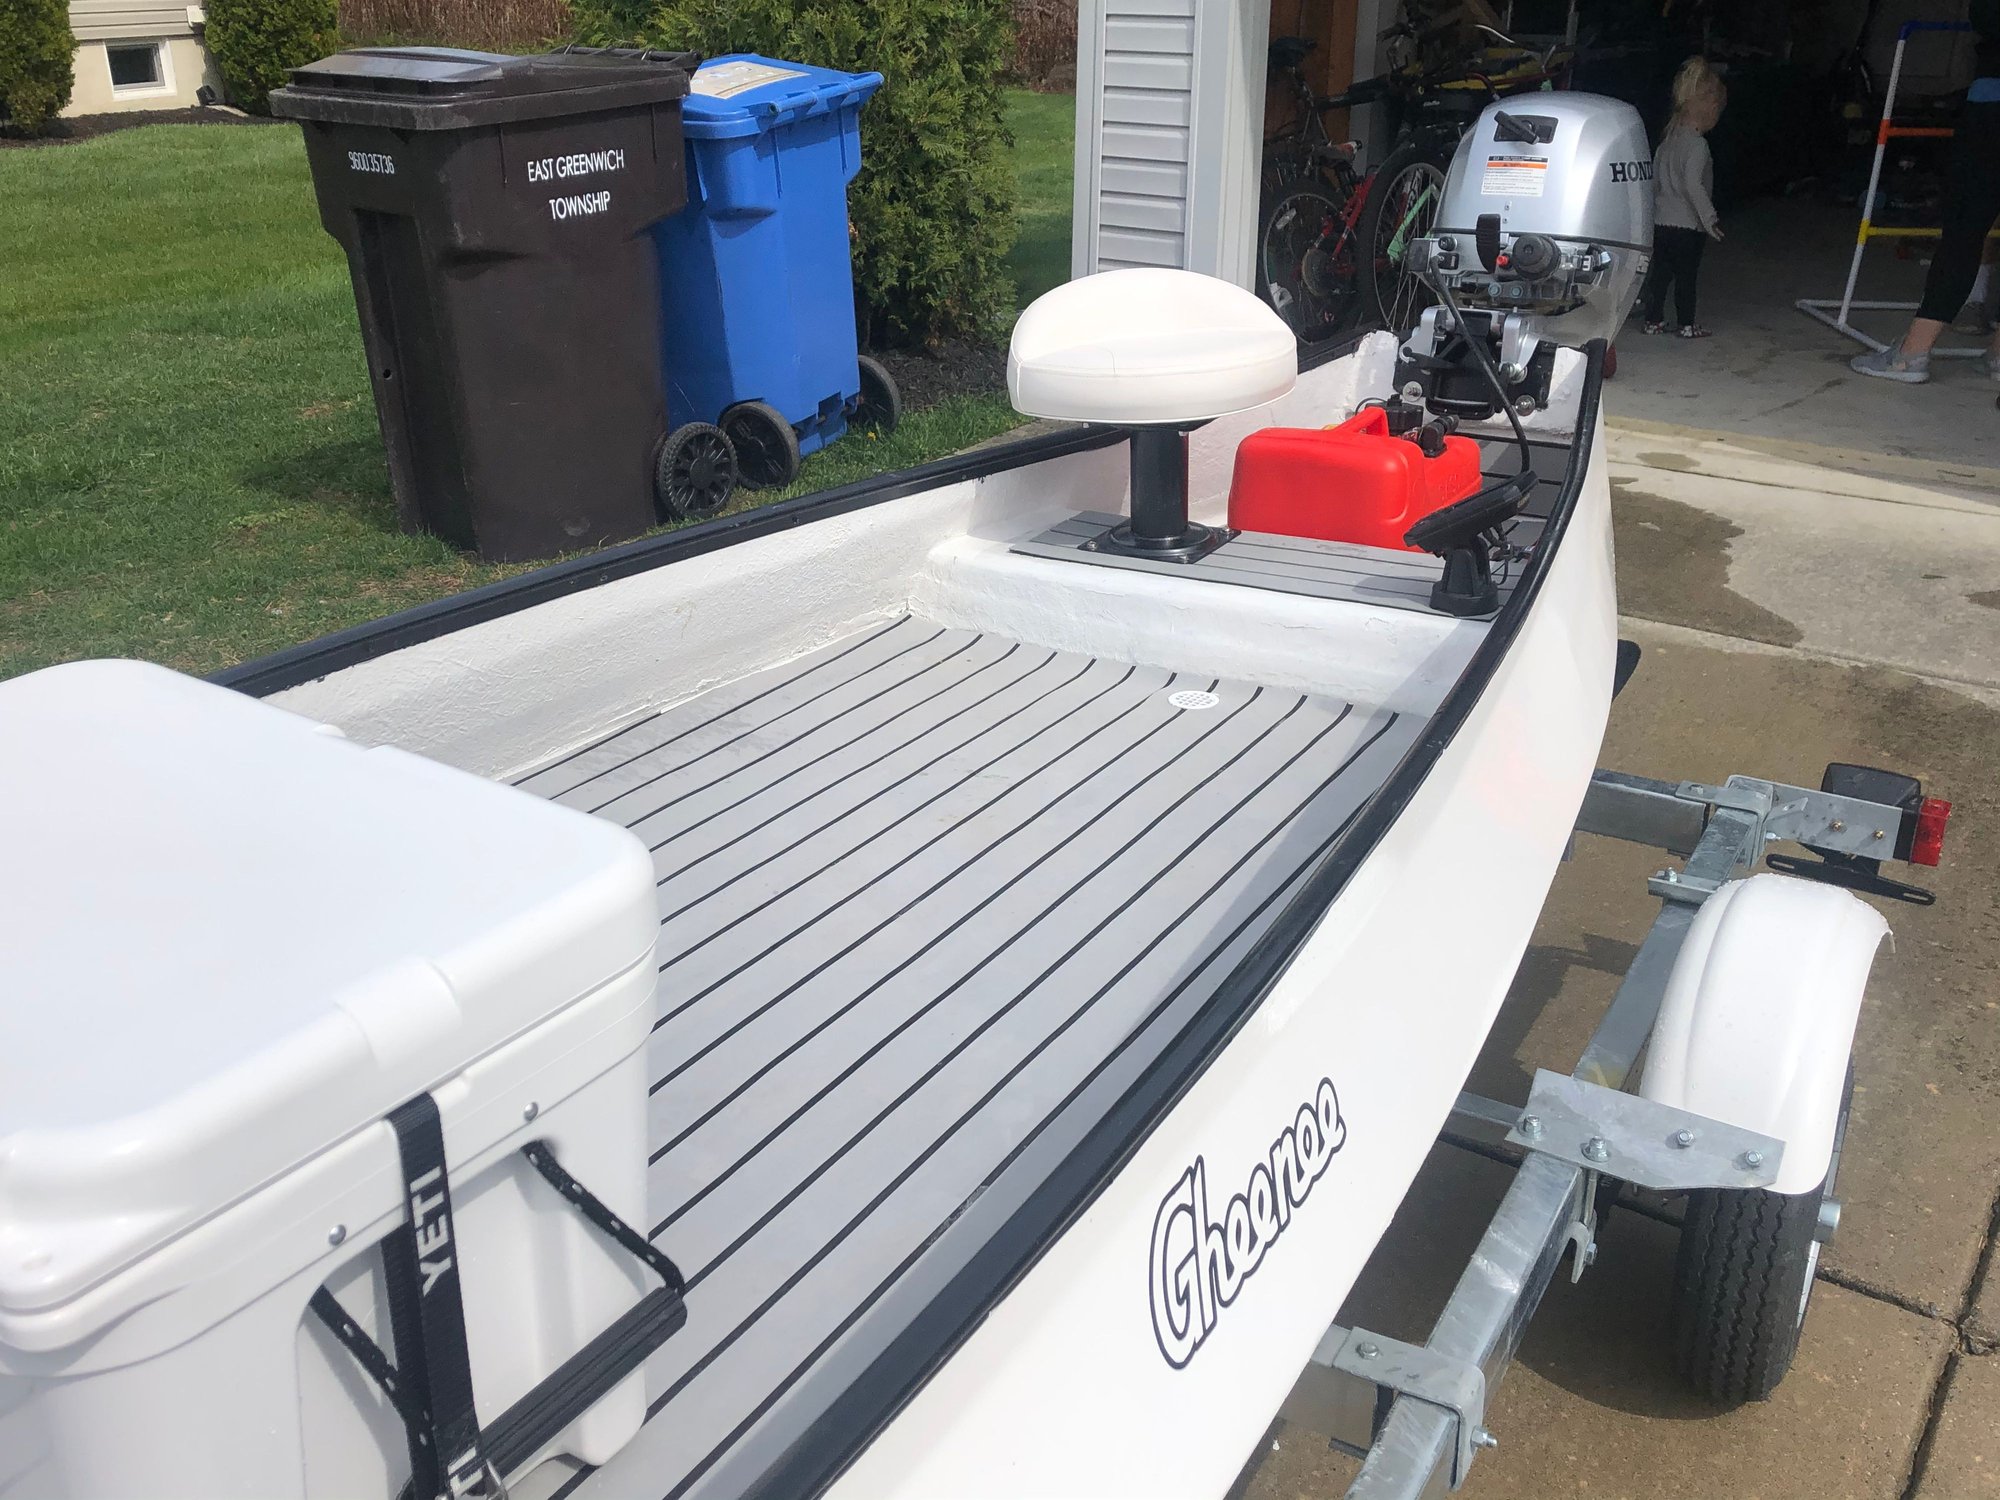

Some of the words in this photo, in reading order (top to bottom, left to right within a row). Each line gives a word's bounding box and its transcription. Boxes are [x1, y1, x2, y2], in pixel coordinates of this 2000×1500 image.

[527, 159, 554, 182] EAST
[556, 148, 625, 178] GREENWICH
[1609, 160, 1654, 183] HOND
[548, 190, 611, 220] TOWNSHIP
[409, 1165, 452, 1297] YETI
[1149, 1076, 1347, 1370] Gheenoe
